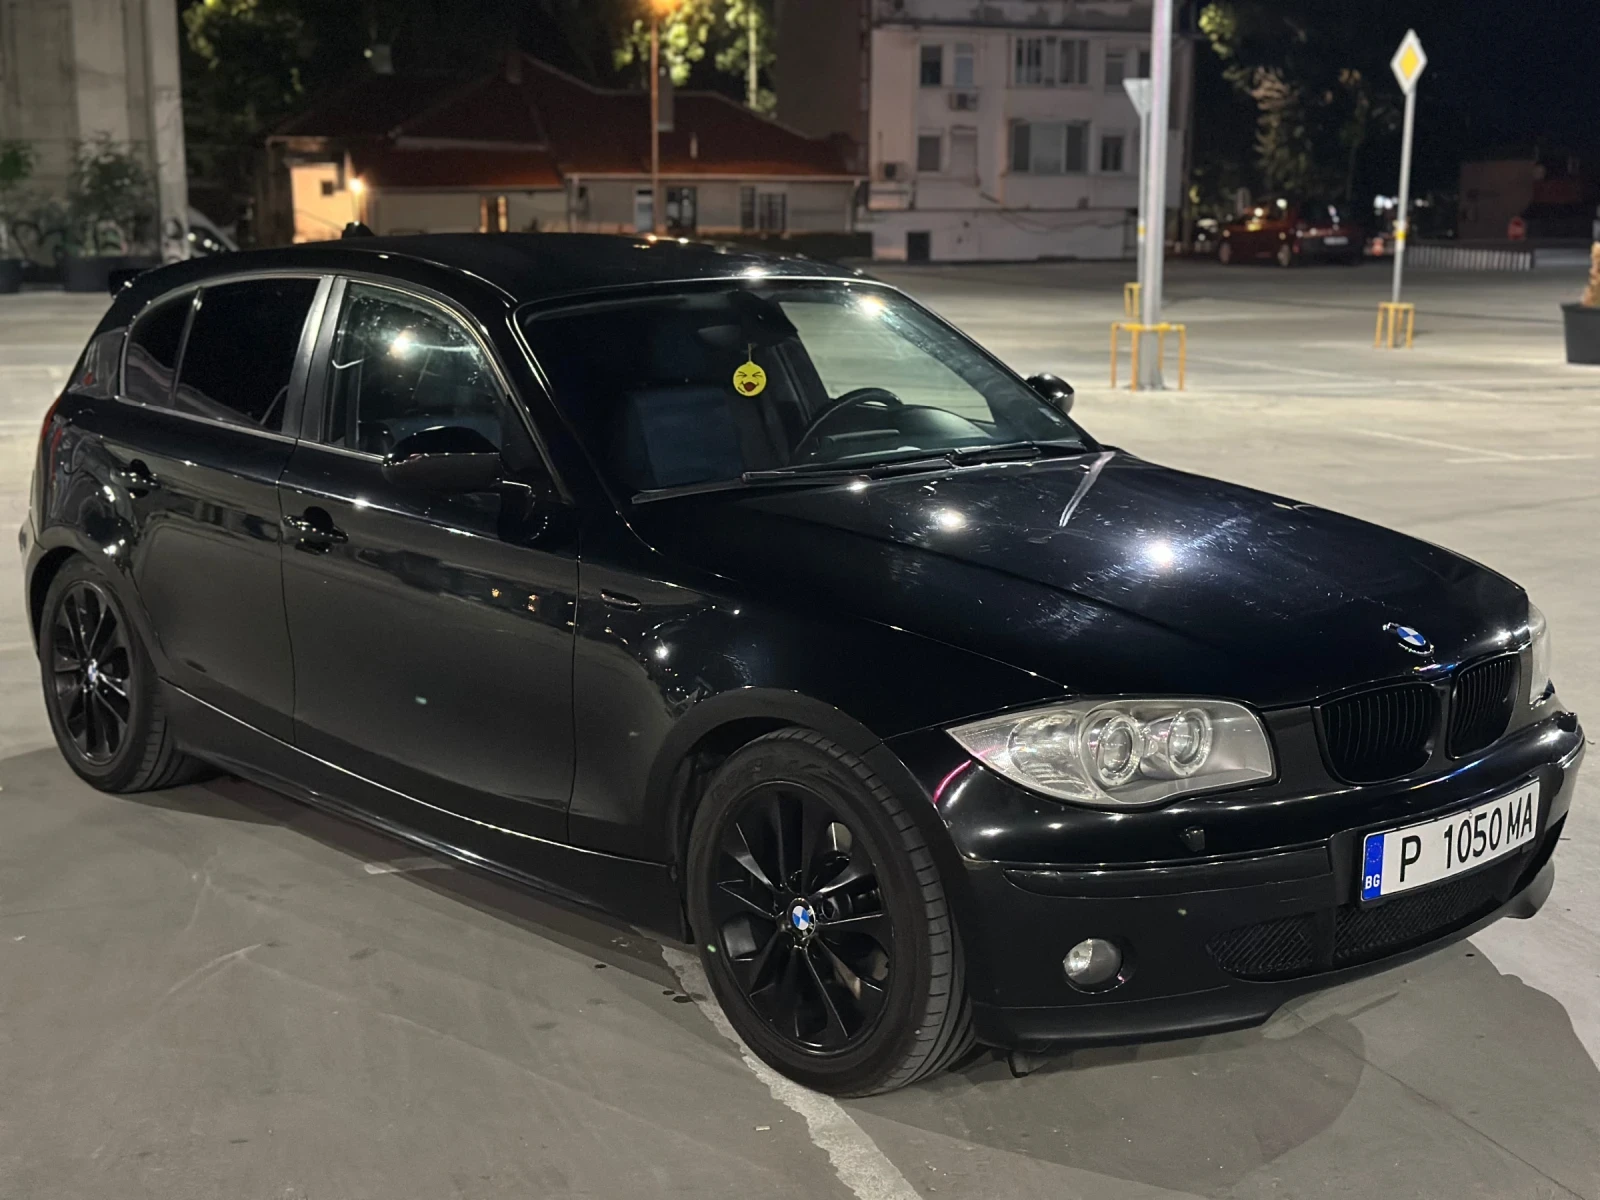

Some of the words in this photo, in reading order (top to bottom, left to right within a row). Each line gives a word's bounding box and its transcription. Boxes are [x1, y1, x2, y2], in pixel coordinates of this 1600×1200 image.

[1400, 835, 1422, 882] P
[1444, 808, 1503, 869] 1050
[1507, 793, 1532, 844] MA
[1365, 874, 1380, 889] BG
